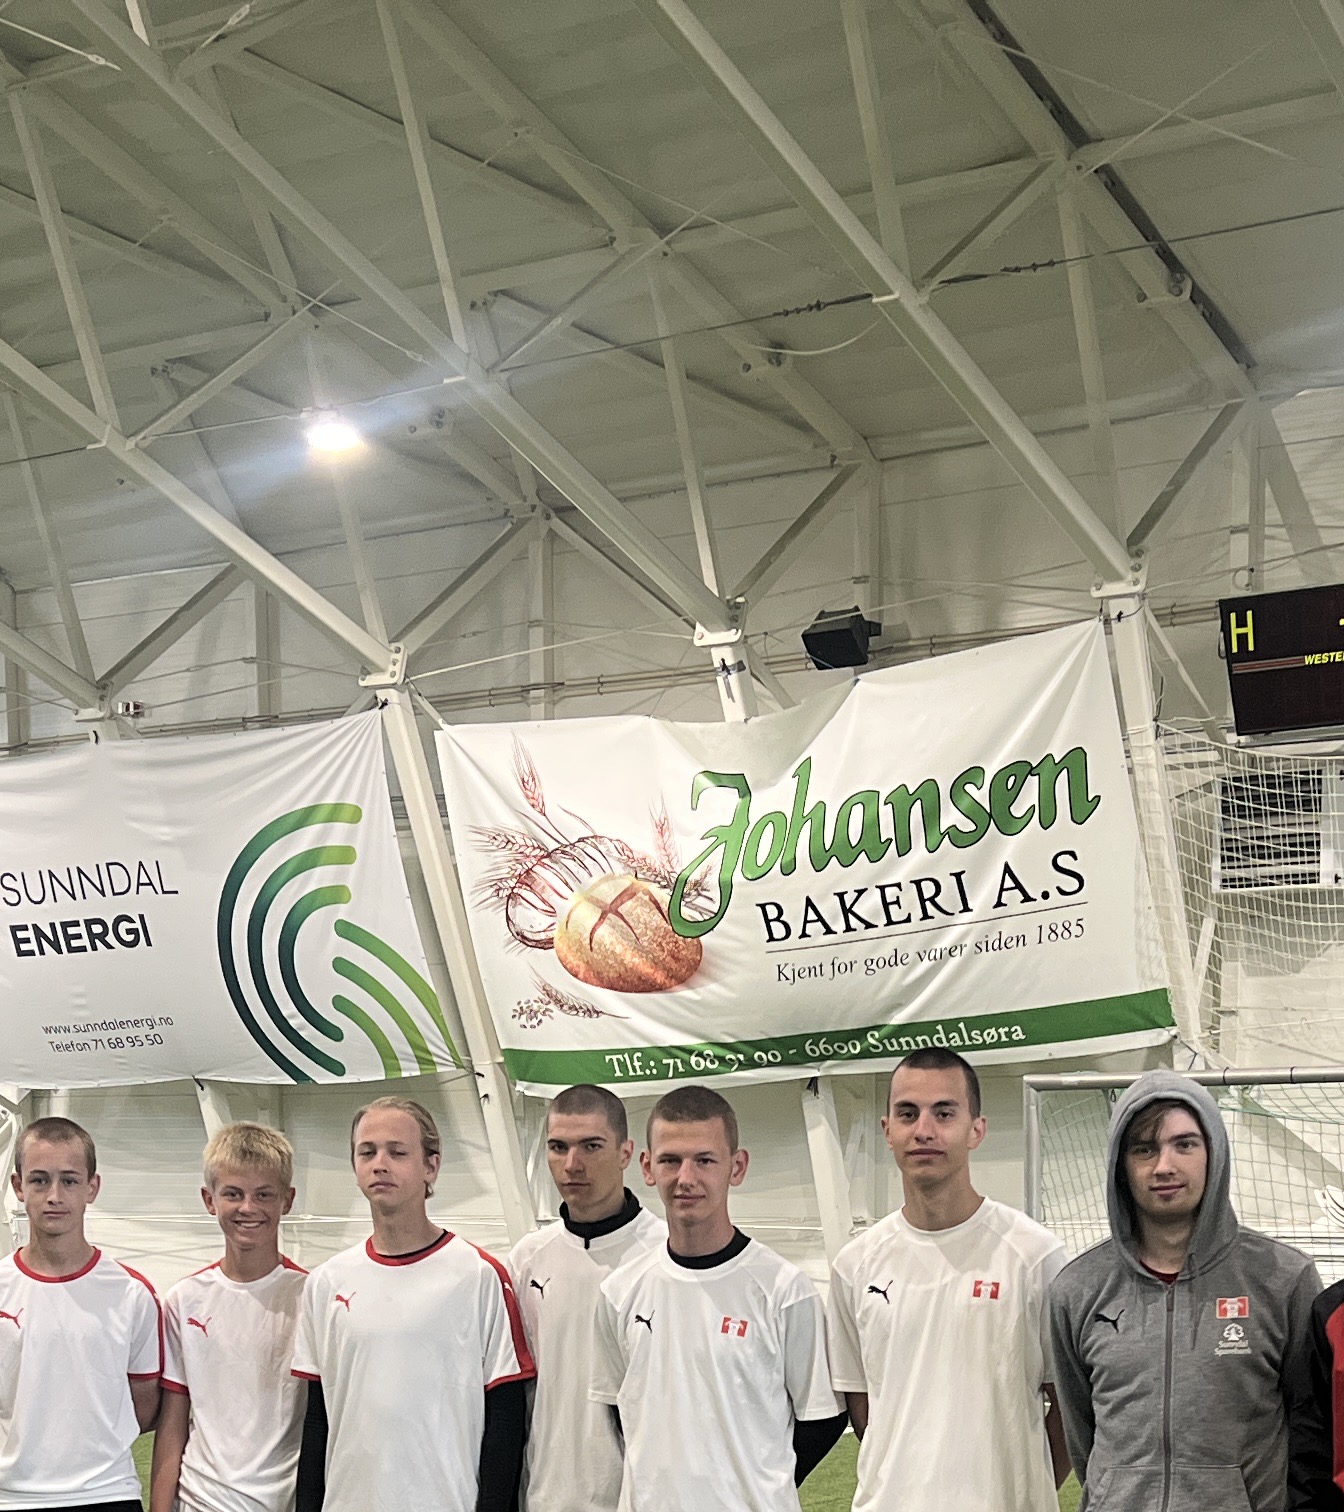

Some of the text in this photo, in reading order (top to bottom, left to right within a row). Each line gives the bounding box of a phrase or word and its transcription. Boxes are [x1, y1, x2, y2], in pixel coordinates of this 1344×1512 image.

[1229, 610, 1254, 653] H
[668, 746, 1101, 938] Johansen
[0, 860, 179, 906] SUNNDAL
[756, 850, 1086, 944] BAKERI A.S
[9, 914, 153, 957] ENERGI
[776, 918, 1085, 985] Kjent for gode varer siden 1885
[42, 1015, 174, 1035] www.sunndalenergi.no
[48, 1033, 164, 1053] Telefon 71 68 95 50
[605, 1052, 657, 1077] Tlf.:
[662, 1058, 685, 1078] 71
[689, 1050, 719, 1071] 68
[753, 1050, 782, 1066] 90
[805, 1038, 861, 1058] 6600
[866, 1021, 1026, 1054] Sunndalsøra
